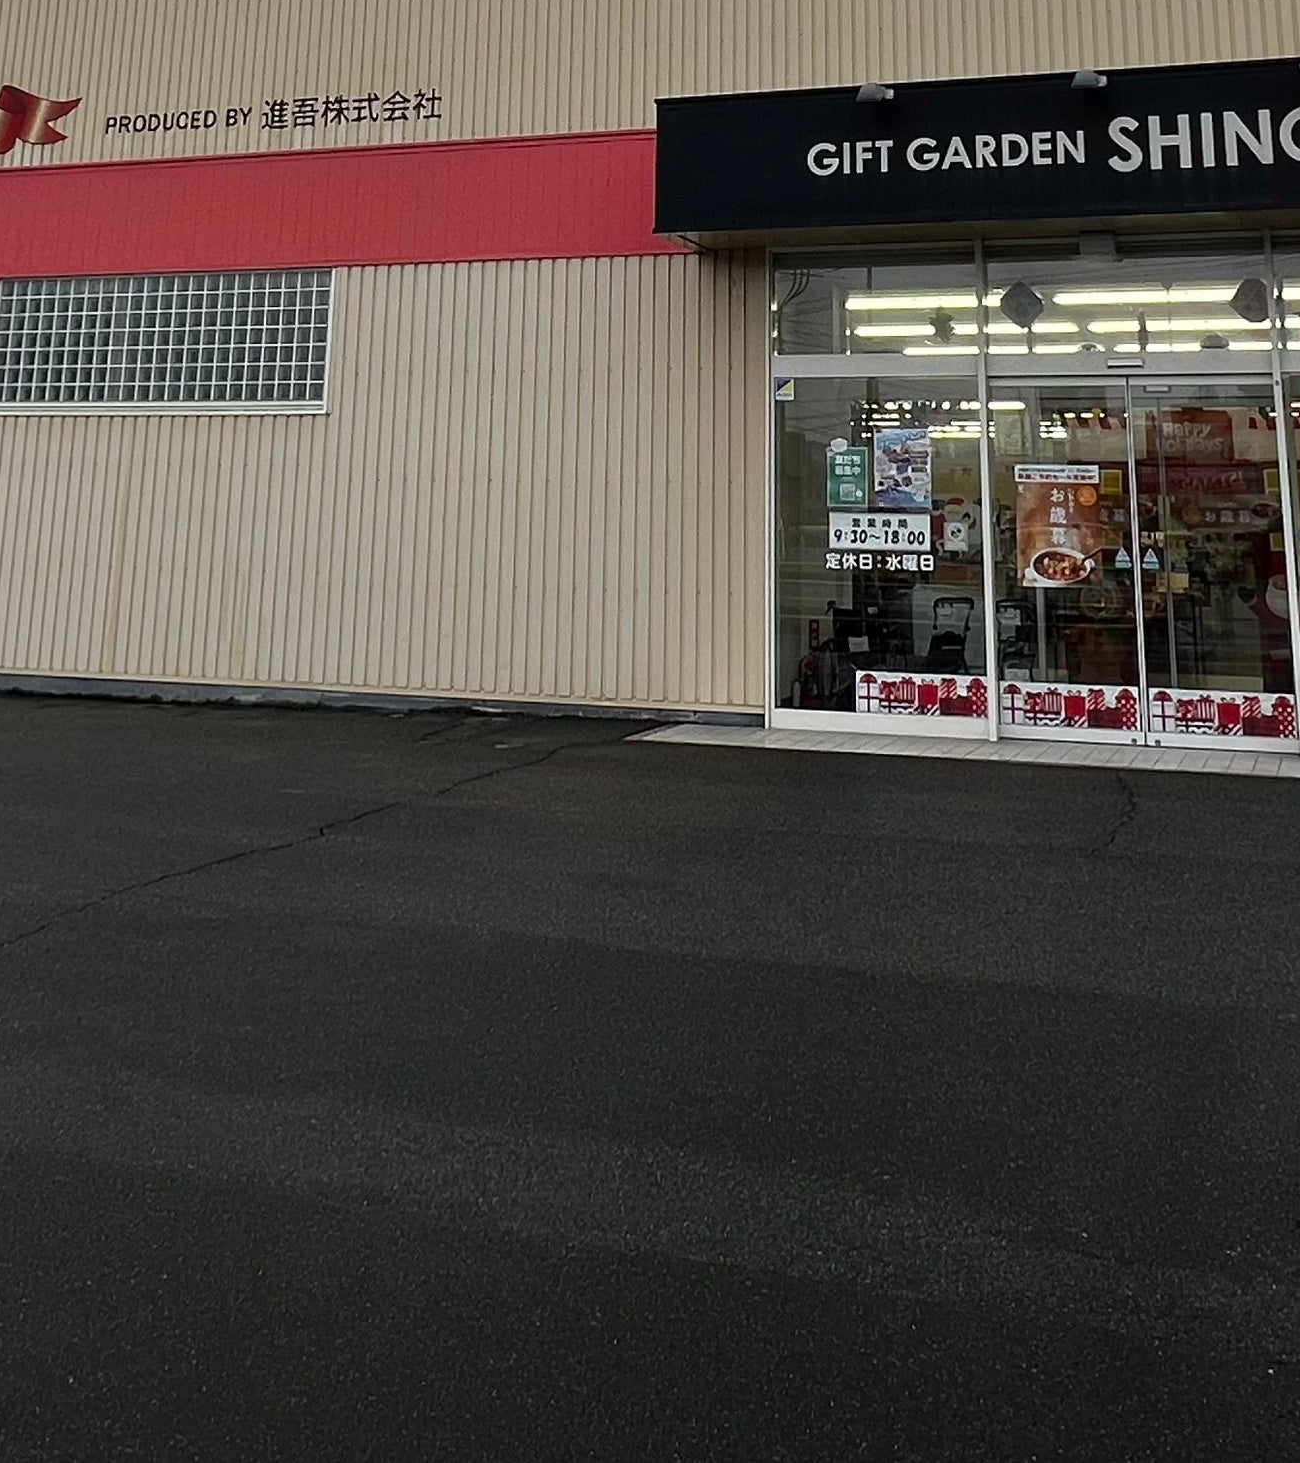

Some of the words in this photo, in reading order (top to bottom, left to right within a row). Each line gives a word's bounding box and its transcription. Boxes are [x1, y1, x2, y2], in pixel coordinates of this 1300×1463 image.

[105, 110, 217, 134] PRODUCED
[225, 107, 252, 127] BY
[261, 88, 442, 130] 進吾株式会社
[807, 140, 894, 176] GIFT
[906, 130, 1086, 171] GARDEN
